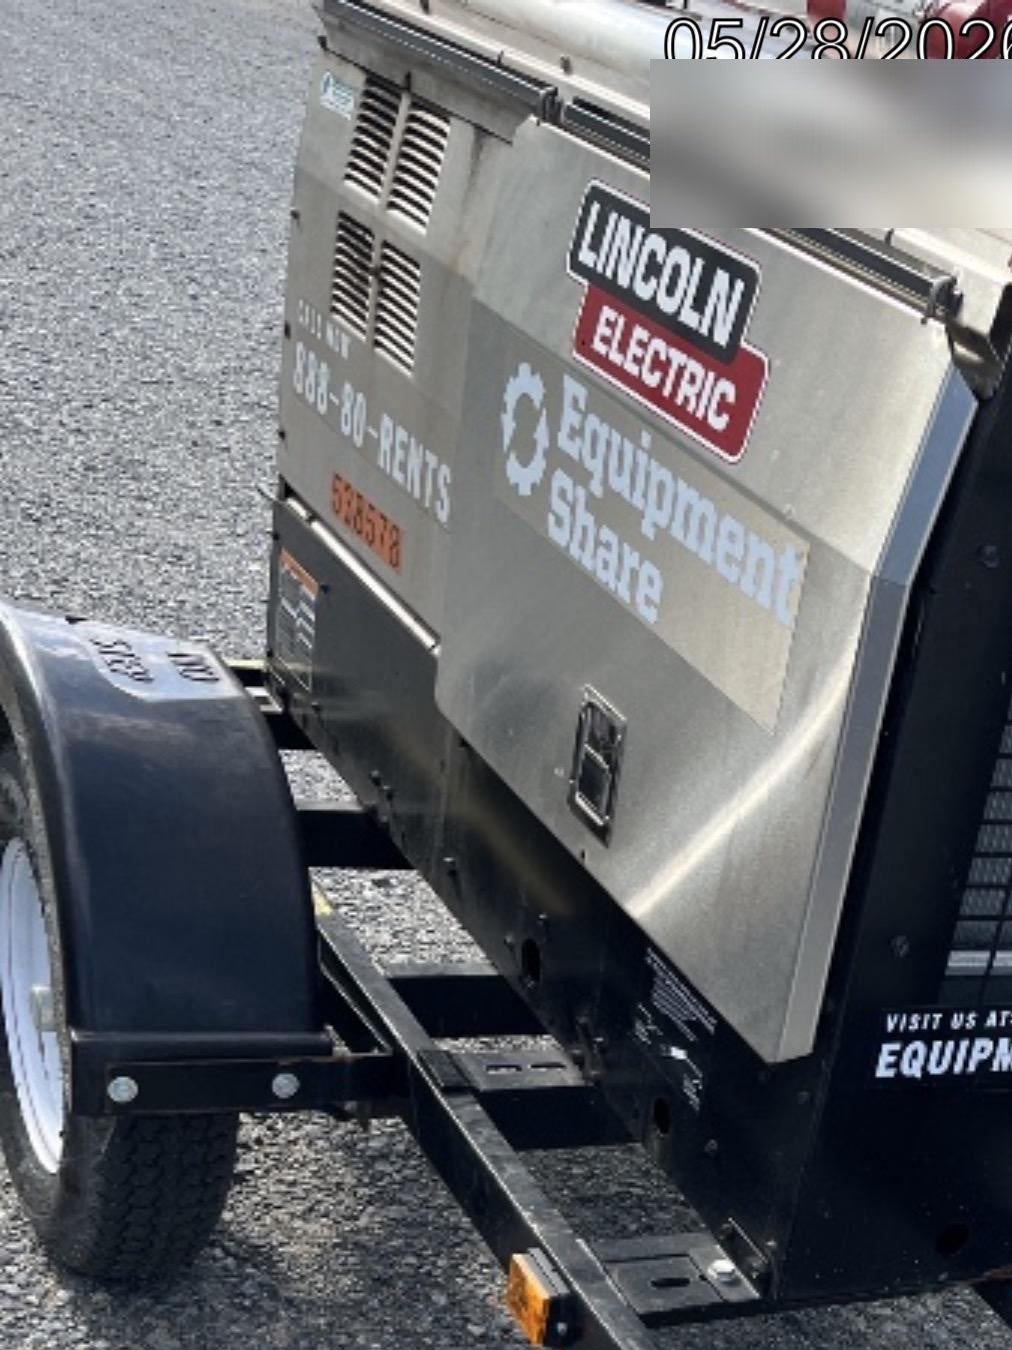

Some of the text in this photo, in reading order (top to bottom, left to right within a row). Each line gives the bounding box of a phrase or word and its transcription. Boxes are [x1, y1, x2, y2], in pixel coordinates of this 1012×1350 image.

[577, 200, 745, 348] LINCOLN
[293, 341, 451, 523] 888-80-RENTS
[591, 304, 737, 432] ELECTRIC
[548, 467, 663, 625] Share
[557, 373, 803, 625] Equipment
[886, 1013, 943, 1032] VISIT
[951, 1012, 978, 1029] US
